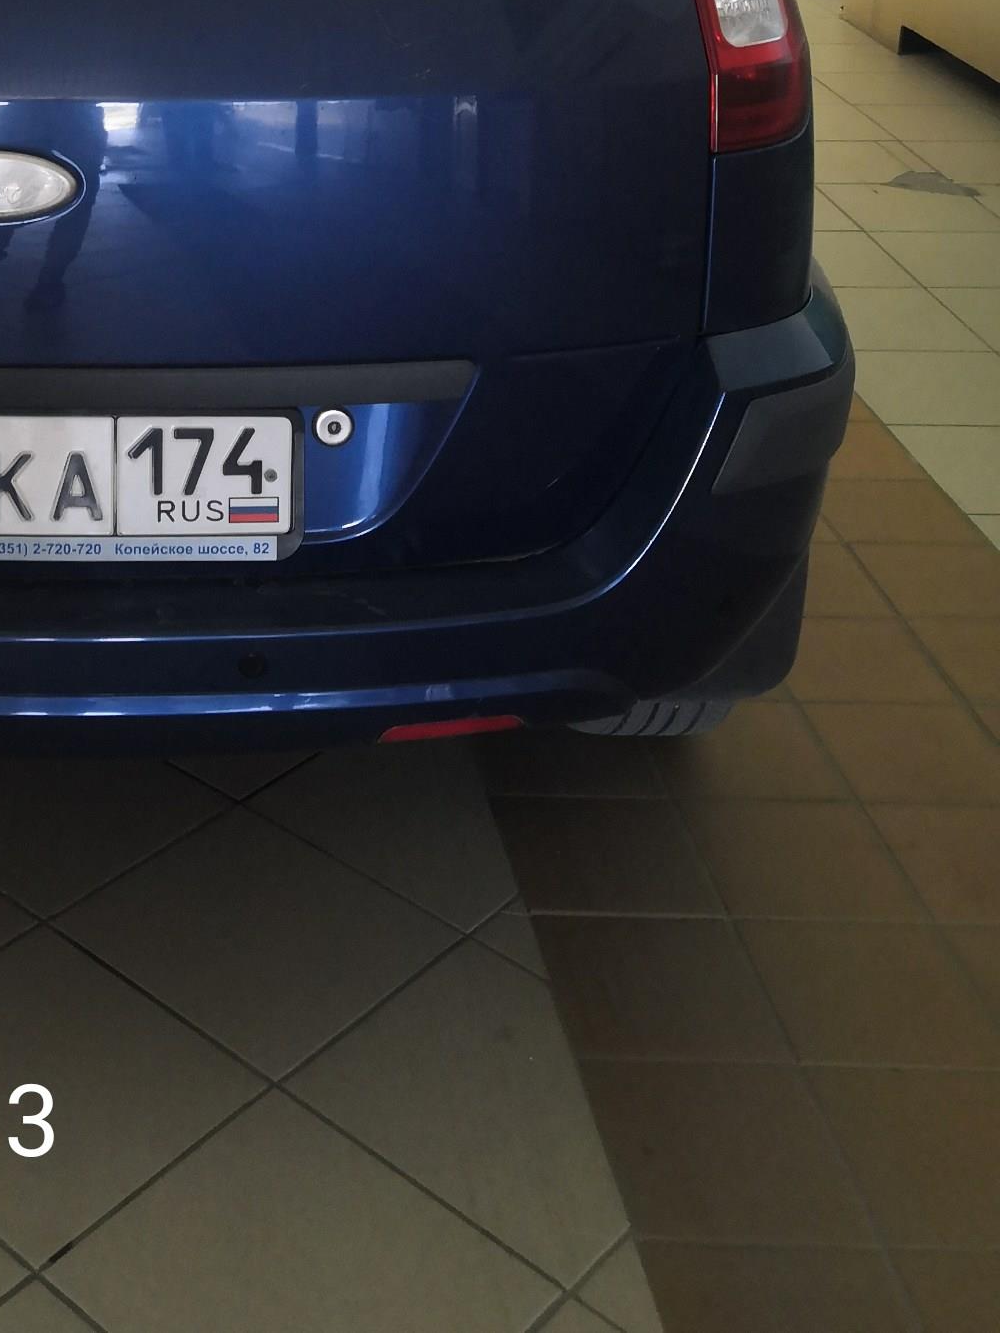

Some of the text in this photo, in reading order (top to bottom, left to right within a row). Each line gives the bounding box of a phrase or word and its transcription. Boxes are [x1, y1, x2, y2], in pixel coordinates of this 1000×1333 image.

[127, 427, 263, 496] 174
[156, 499, 225, 523] RUS
[33, 542, 102, 555] 2-720-720
[114, 541, 193, 555] Копейское
[198, 545, 248, 557] шоссе,
[253, 542, 269, 554] 82
